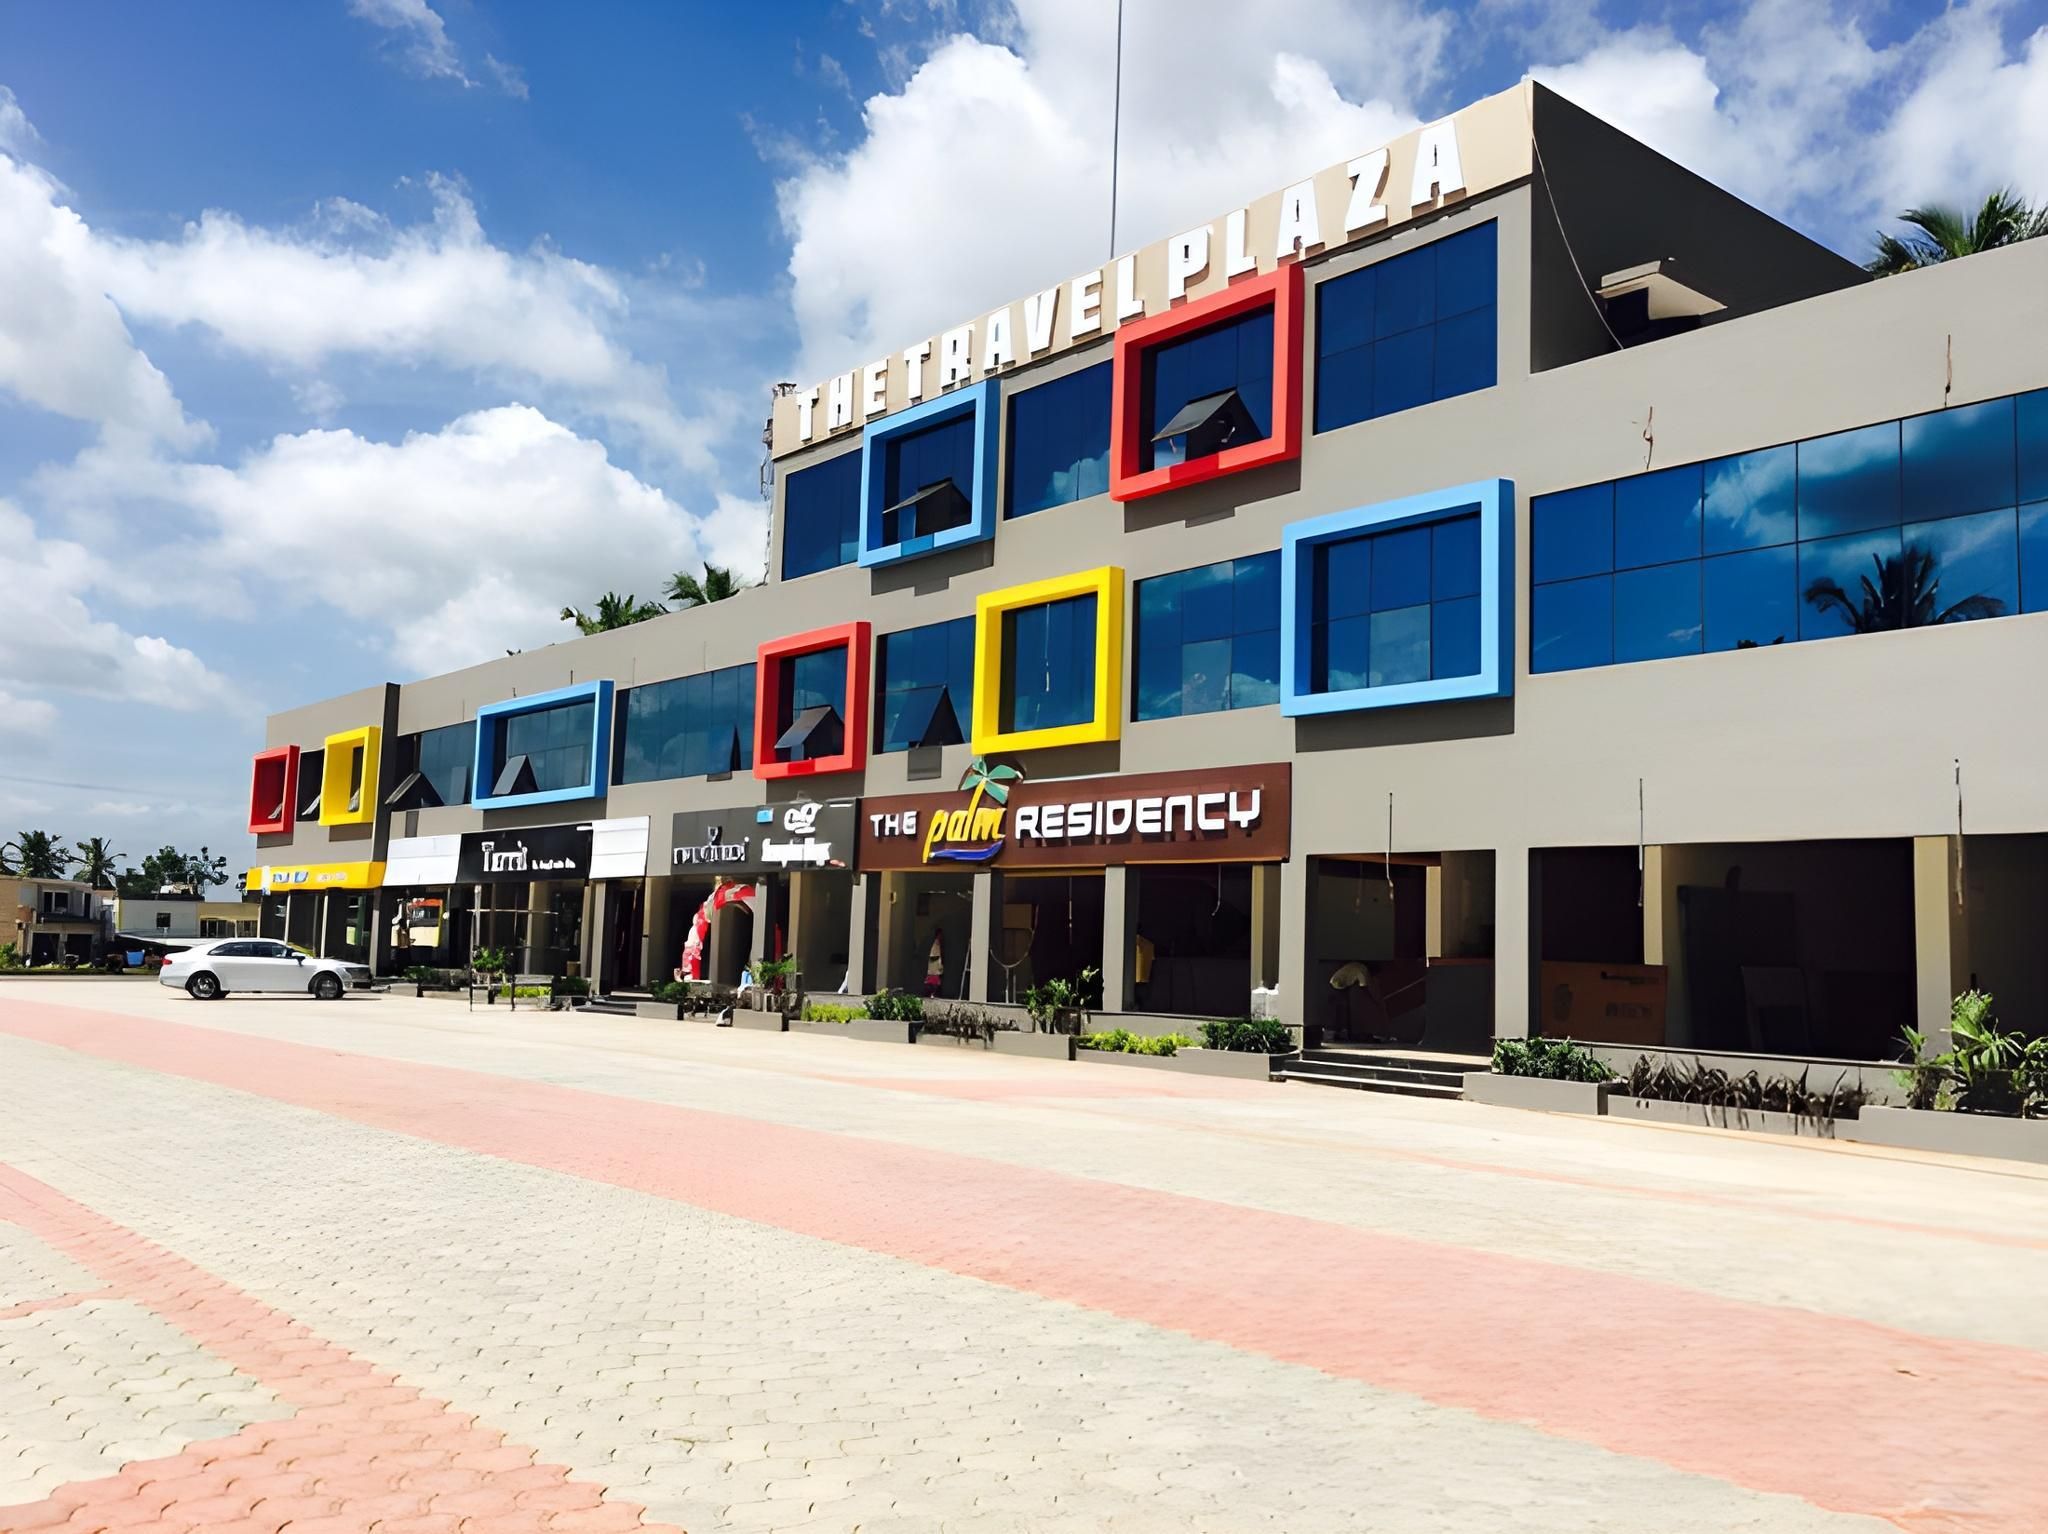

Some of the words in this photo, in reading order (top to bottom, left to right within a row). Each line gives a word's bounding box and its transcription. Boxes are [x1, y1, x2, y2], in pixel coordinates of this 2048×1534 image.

[796, 358, 888, 441] THE
[903, 254, 1145, 399] TRAVEL
[1168, 117, 1465, 301] PLAZA
[869, 810, 918, 838] THE
[922, 779, 1008, 864] palm
[1014, 788, 1262, 840] RESIDENCY
